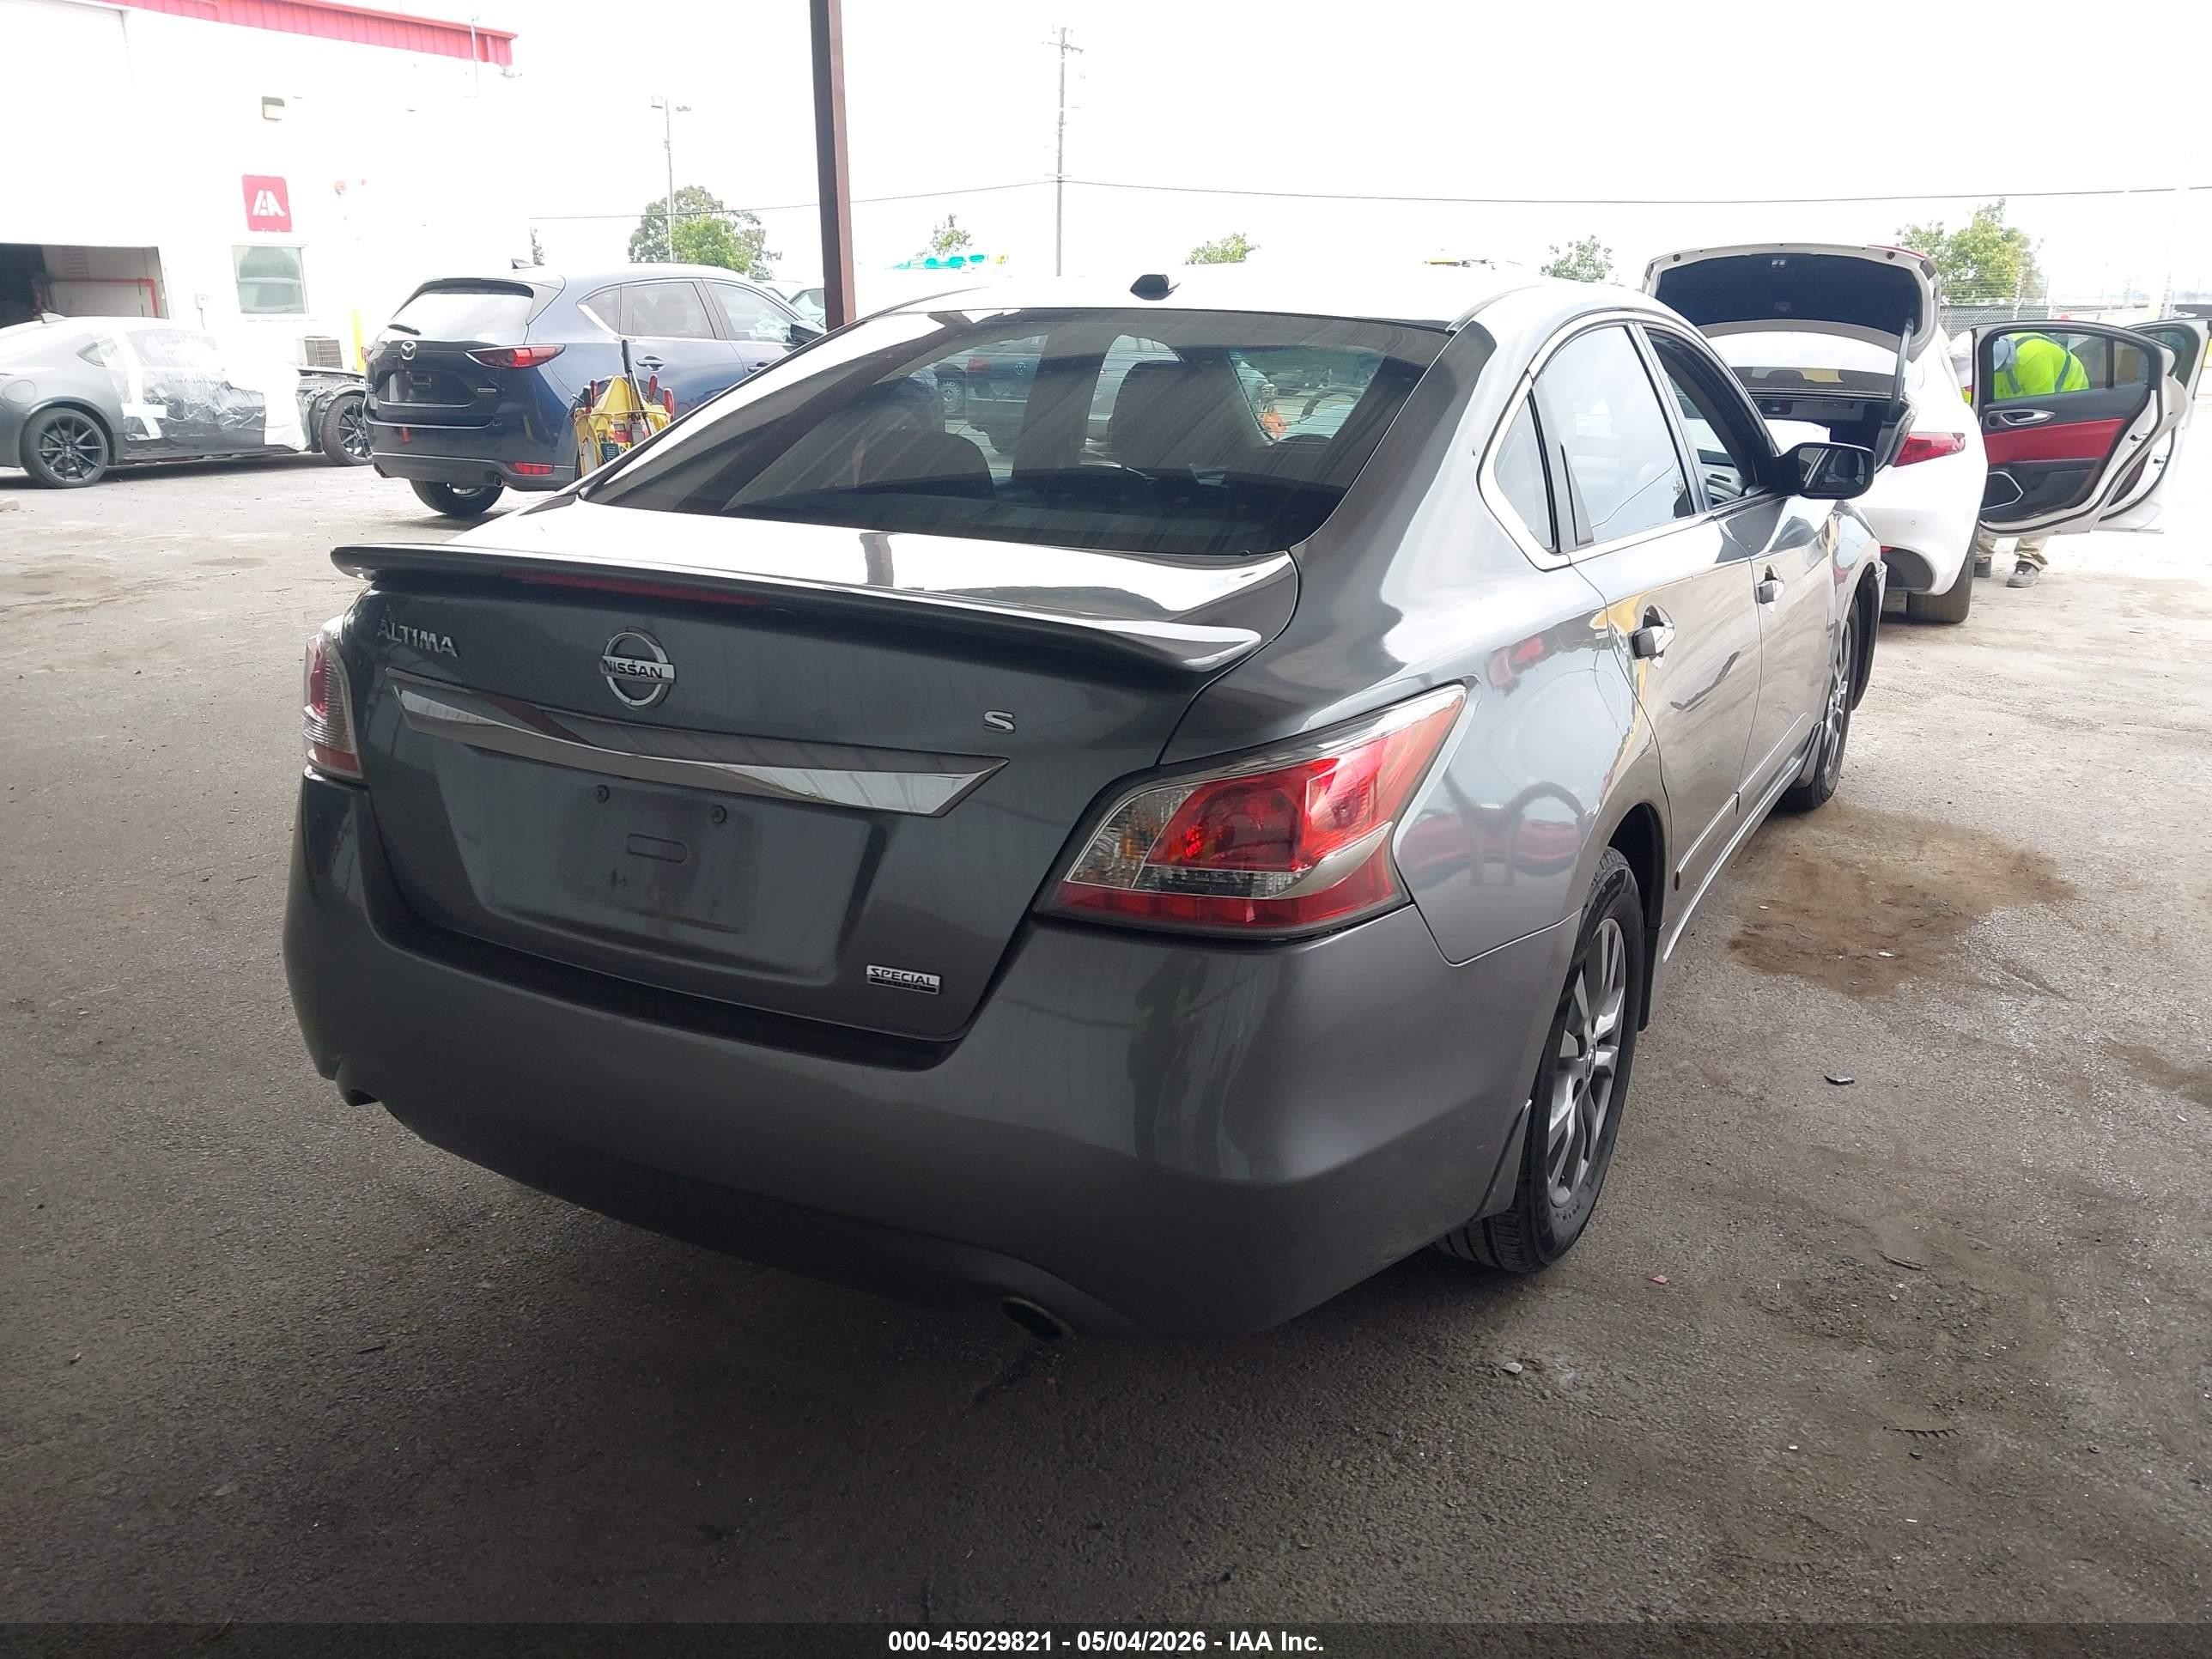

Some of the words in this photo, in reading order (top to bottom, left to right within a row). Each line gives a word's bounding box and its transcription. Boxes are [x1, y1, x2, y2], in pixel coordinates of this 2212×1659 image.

[378, 619, 459, 658] ALTIMA
[604, 659, 663, 679] NISSAN
[983, 710, 1016, 734] S
[870, 967, 937, 987] SPECIAL
